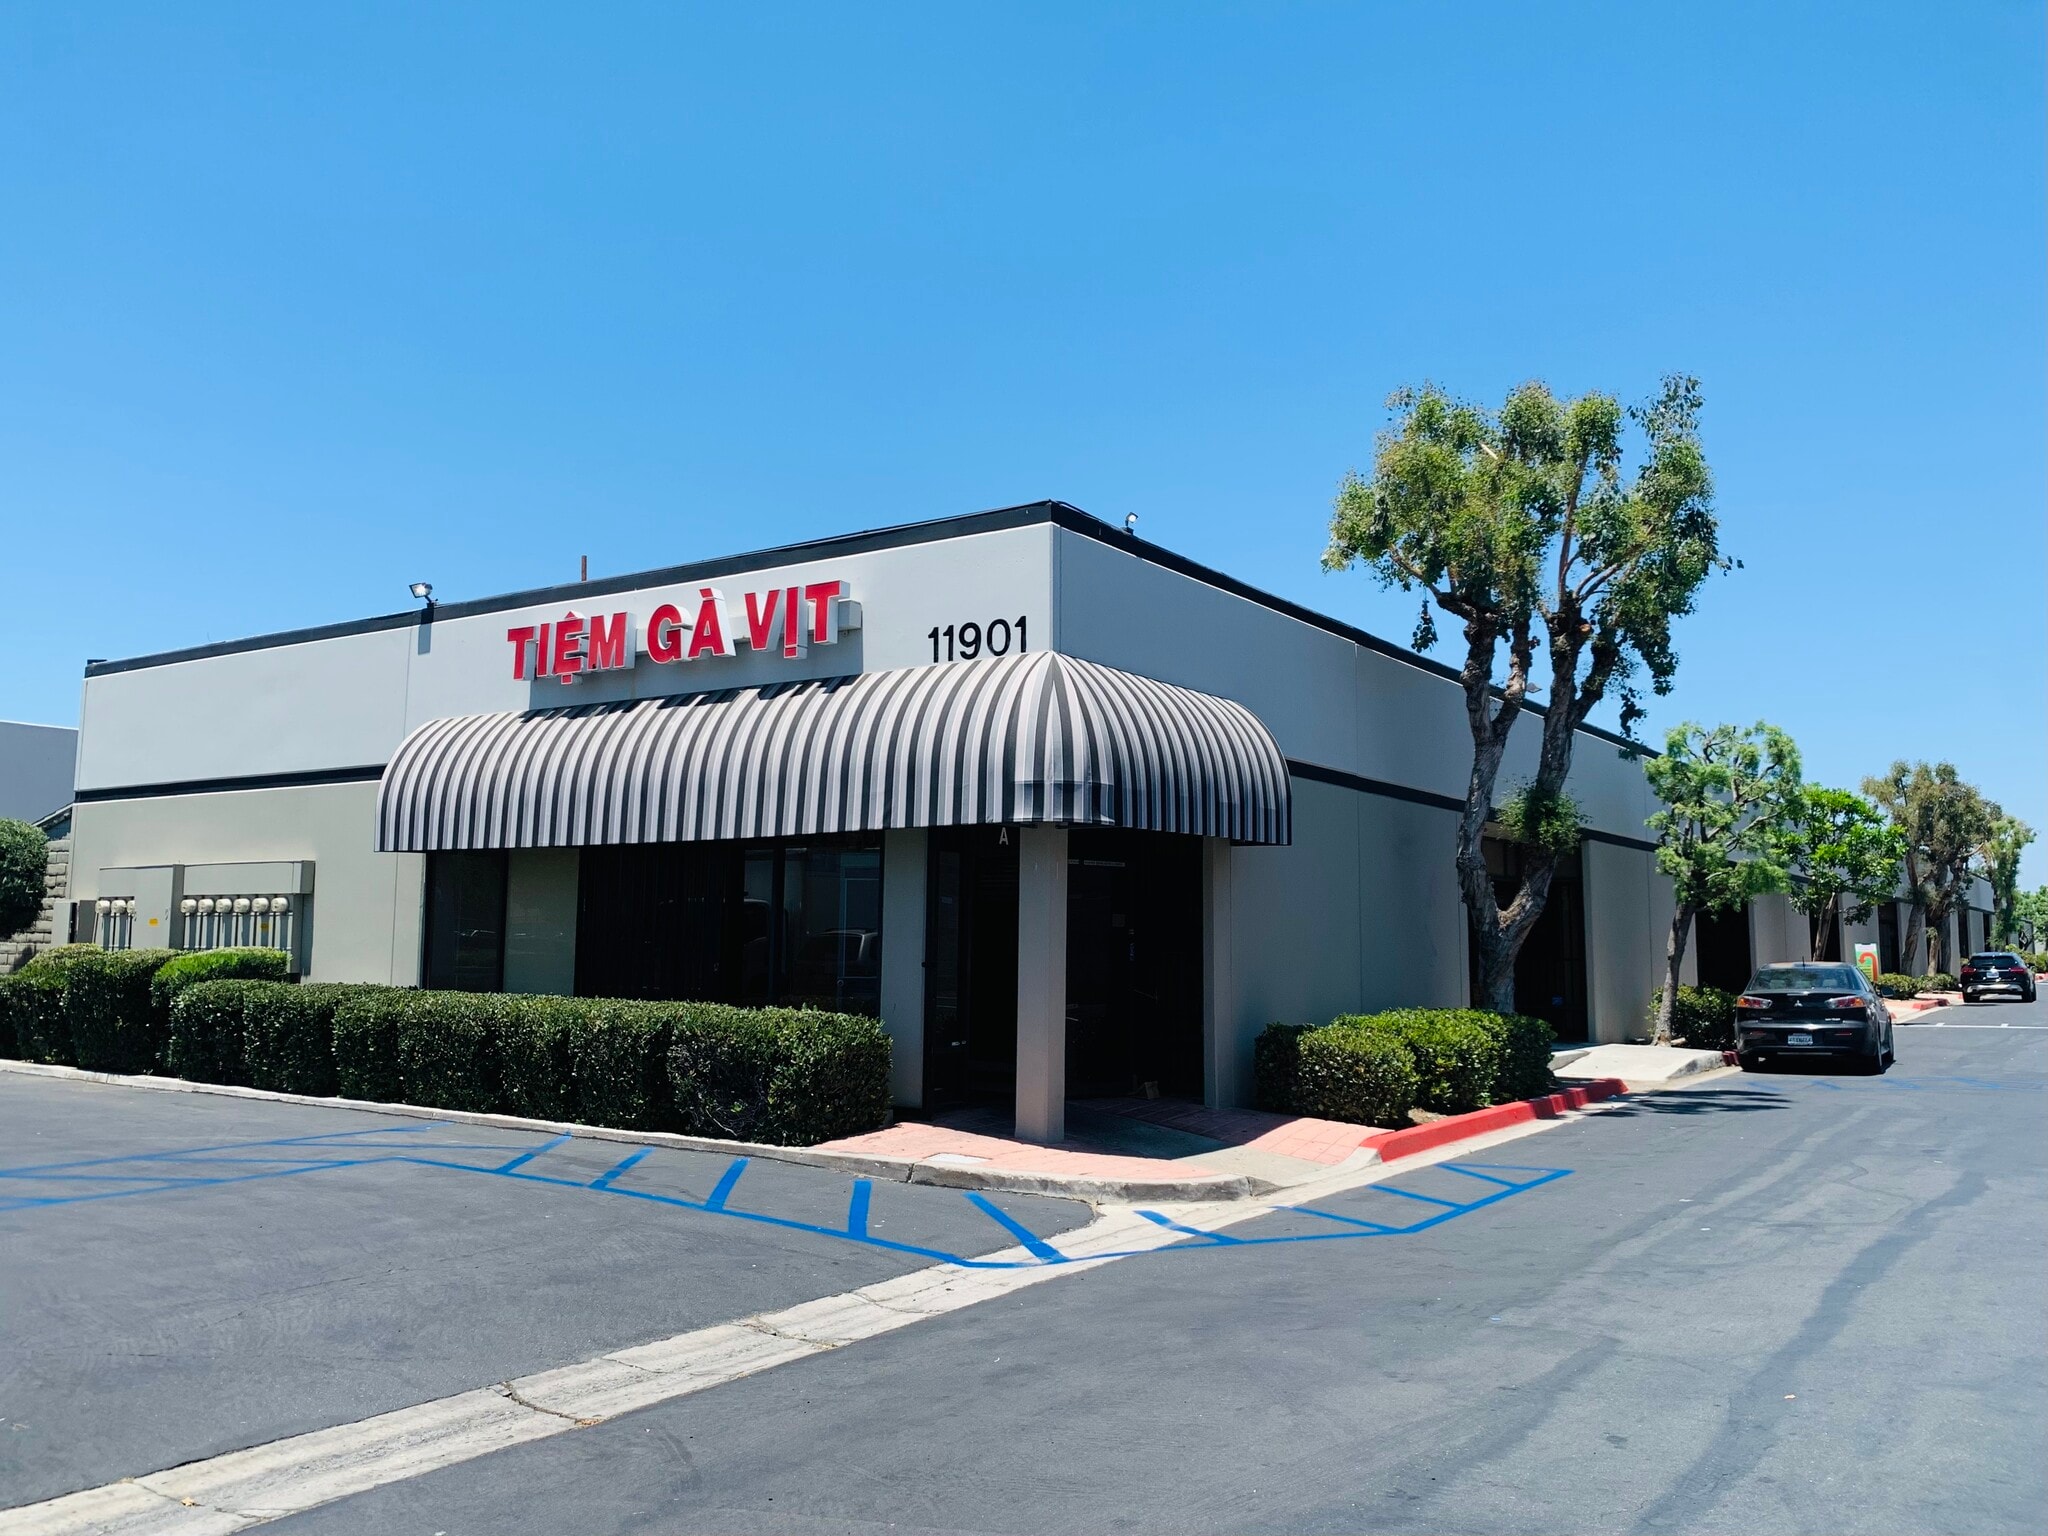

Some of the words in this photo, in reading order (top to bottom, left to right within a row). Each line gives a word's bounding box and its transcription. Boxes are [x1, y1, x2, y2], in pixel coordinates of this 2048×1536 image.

[507, 611, 628, 685] TIỆM
[647, 587, 726, 664] GÀ
[744, 580, 841, 659] VỊT
[927, 616, 1027, 663] 11901
[999, 826, 1009, 846] A
